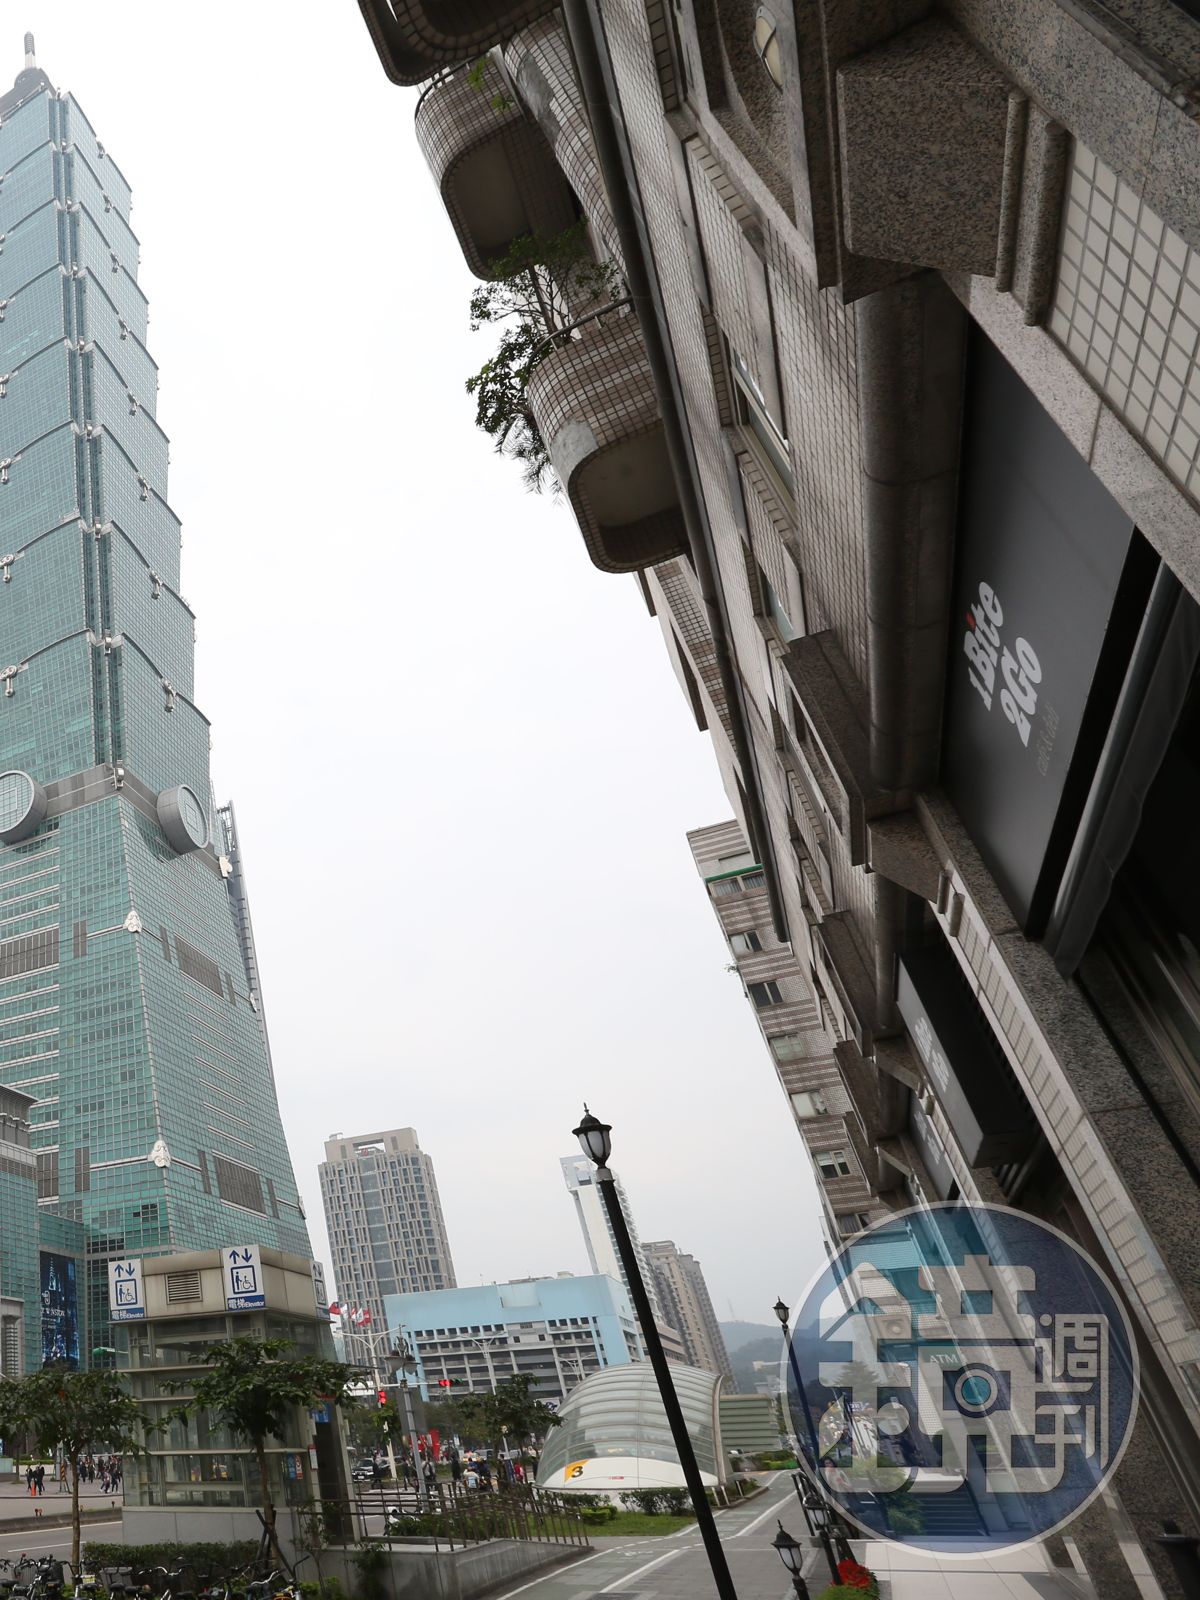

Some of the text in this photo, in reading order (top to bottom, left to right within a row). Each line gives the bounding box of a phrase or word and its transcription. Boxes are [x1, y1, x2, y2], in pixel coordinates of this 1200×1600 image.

[1000, 637, 1042, 747] 2Go
[228, 1297, 264, 1310] 電梯 Elevator
[111, 1309, 127, 1320] 電梯
[929, 1353, 959, 1364] ATM
[571, 1465, 584, 1478] 3
